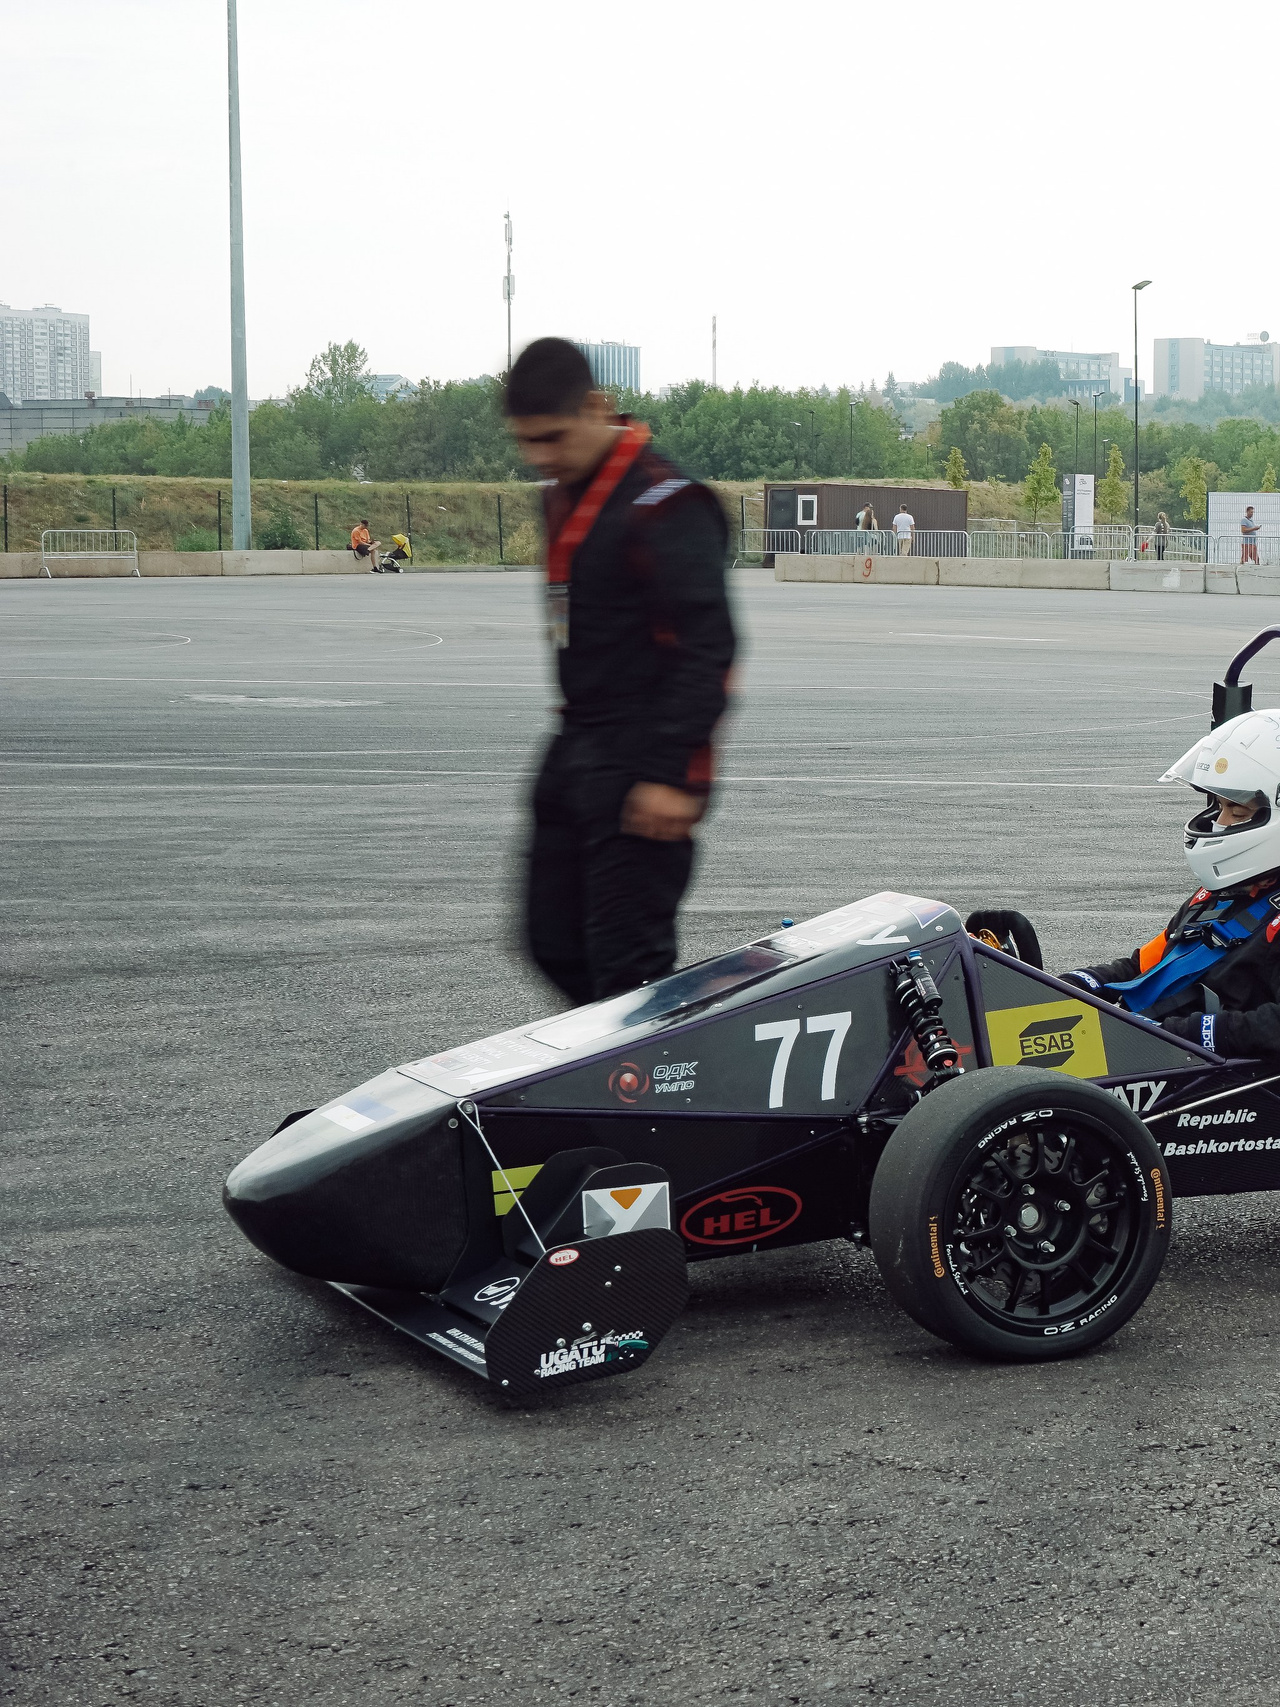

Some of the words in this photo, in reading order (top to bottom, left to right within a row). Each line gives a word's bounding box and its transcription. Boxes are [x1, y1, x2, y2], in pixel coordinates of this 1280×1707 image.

[862, 557, 872, 577] 9
[1019, 1032, 1075, 1056] ESAB
[653, 1060, 698, 1080] ОДК
[754, 1011, 852, 1109] 77
[655, 1080, 695, 1094] УМПО
[1177, 1109, 1258, 1129] Republic
[978, 1117, 1018, 1149] RACING
[1150, 1168, 1166, 1222] Continental
[703, 1207, 782, 1236] HEL
[554, 1254, 574, 1263] HEL
[929, 1223, 945, 1278] Continental
[1079, 1294, 1118, 1326] RACING
[540, 1340, 606, 1369] UGATU
[540, 1361, 577, 1378] RACING
[577, 1353, 605, 1369] TEAM
